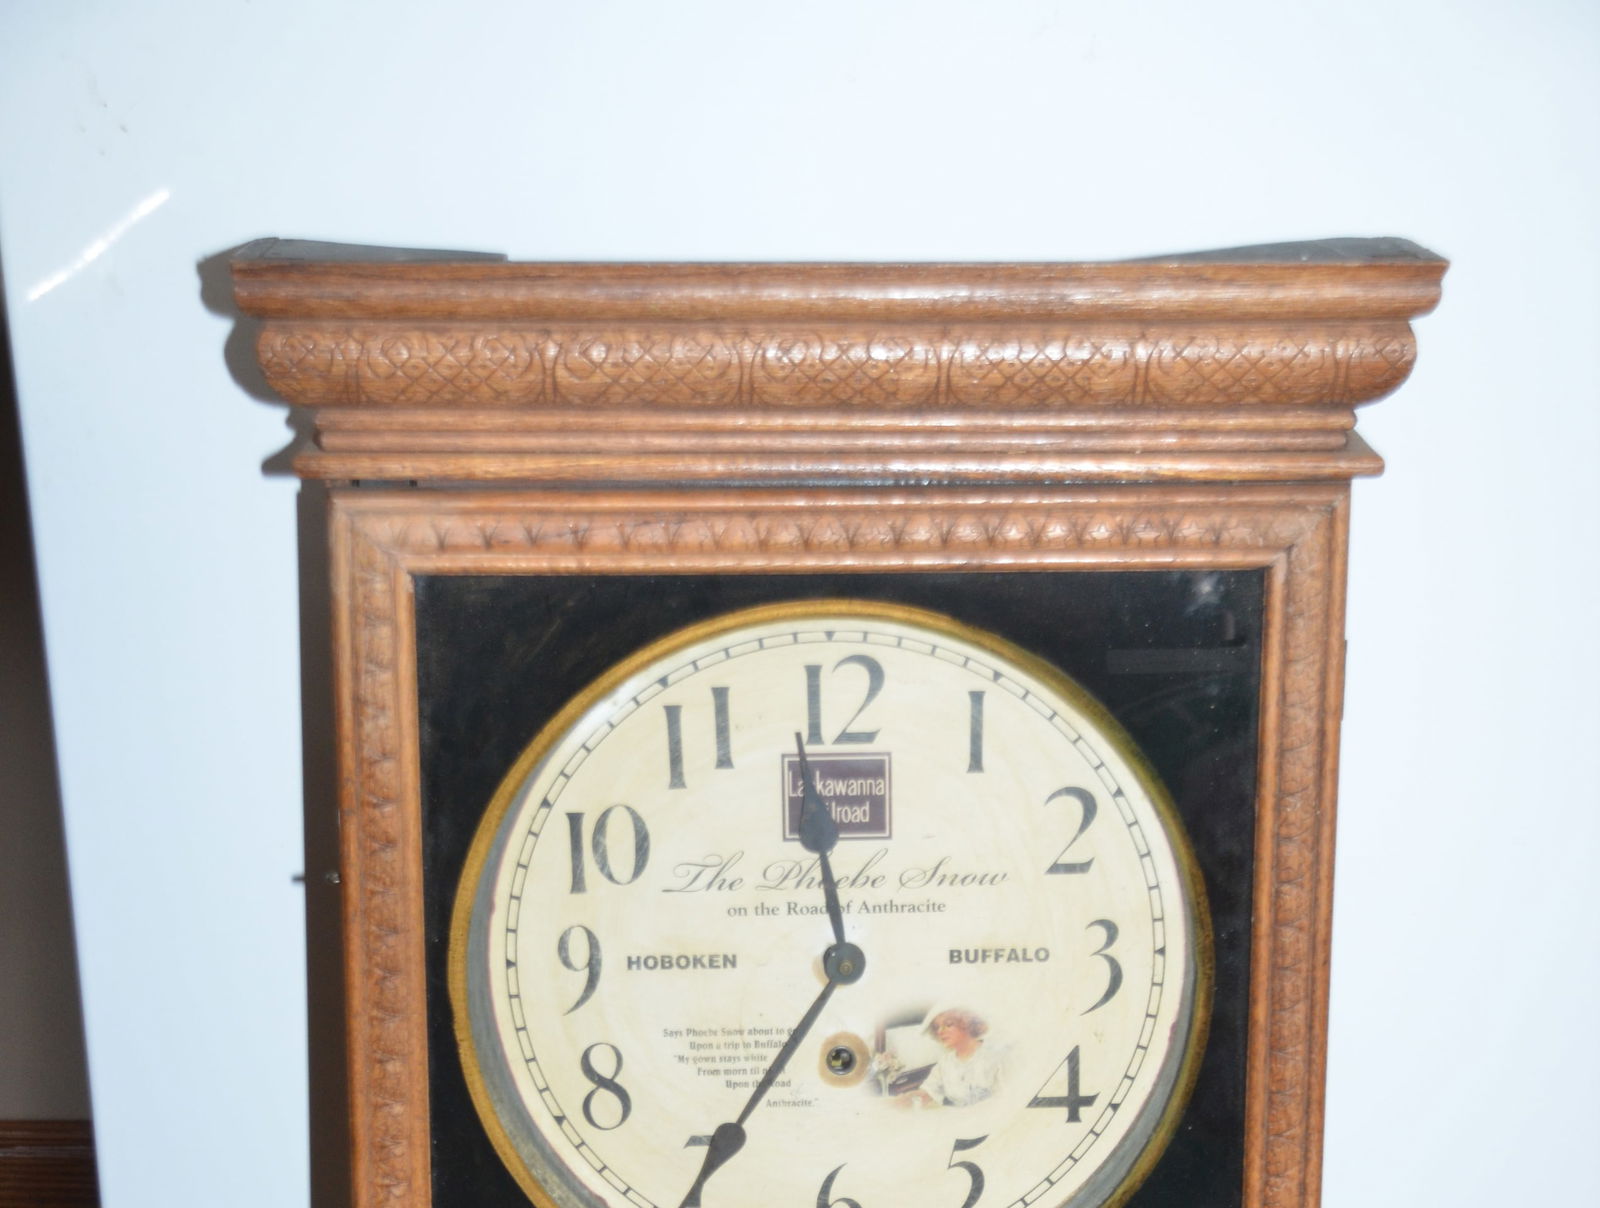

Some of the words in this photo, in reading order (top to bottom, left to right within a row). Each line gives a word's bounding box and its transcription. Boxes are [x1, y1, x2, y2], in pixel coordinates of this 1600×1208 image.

[803, 654, 886, 745] 12
[662, 686, 736, 790] 11
[965, 690, 987, 774] 1
[788, 768, 886, 798] Lakawanna
[804, 800, 870, 824] lroad
[565, 803, 651, 895] 10
[1043, 786, 1099, 876] 2
[661, 849, 745, 893] The
[898, 855, 1009, 892] Snow
[726, 905, 749, 918] on
[754, 901, 781, 917] the
[857, 899, 947, 916] Anthracite
[556, 924, 604, 1016] 9
[626, 954, 738, 972] HOBOKEN
[948, 946, 1051, 966] BUFFALO
[1078, 917, 1125, 1017] 3
[663, 1028, 683, 1038] Says
[747, 1027, 774, 1037] about
[775, 1027, 785, 1037] to
[689, 1041, 714, 1052] Upon
[723, 1041, 740, 1051] trip
[742, 1041, 752, 1050] to
[697, 1067, 721, 1077] From
[723, 1067, 748, 1076] morn
[718, 1055, 741, 1064] stays
[743, 1053, 768, 1063] white
[579, 1041, 634, 1132] 8
[725, 1080, 750, 1089] Upon
[1025, 1044, 1102, 1124] 4
